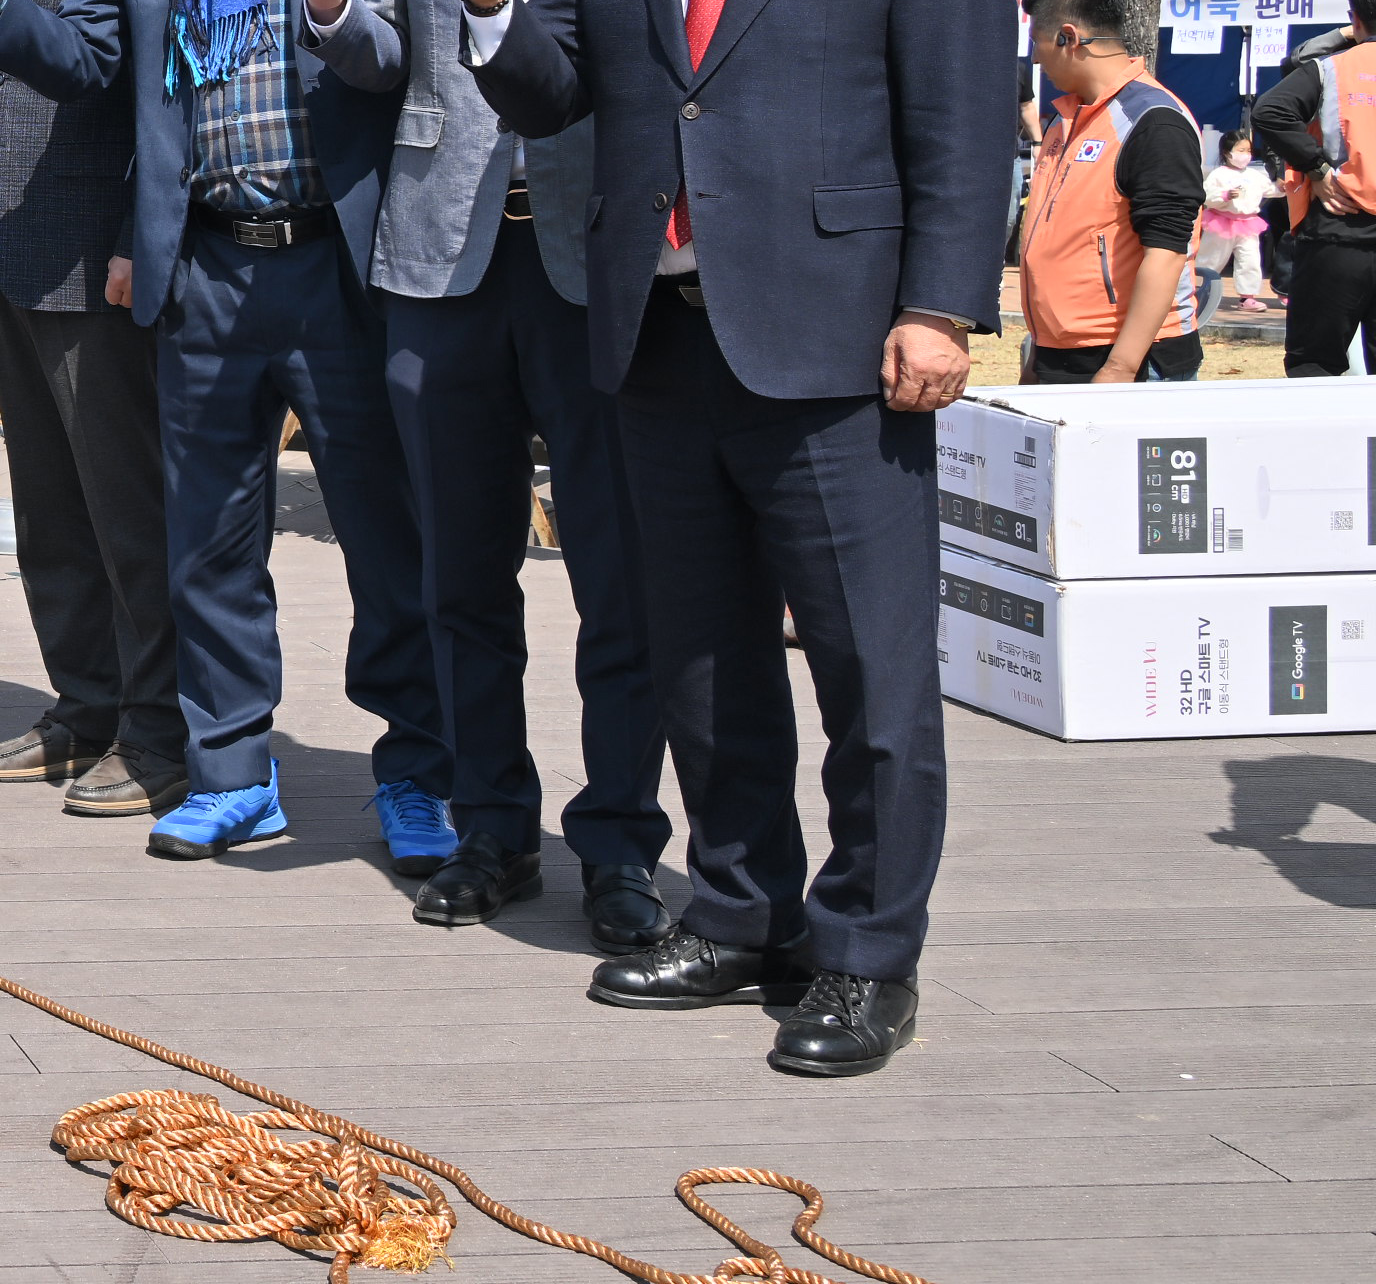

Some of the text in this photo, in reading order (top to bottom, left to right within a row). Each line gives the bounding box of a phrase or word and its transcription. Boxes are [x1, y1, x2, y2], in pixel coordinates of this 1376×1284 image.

[1170, 449, 1196, 481] 81
[1171, 484, 1179, 501] cm
[1015, 520, 1026, 541] 81
[1197, 617, 1212, 715] 구글 스마트 TV
[1291, 620, 1305, 680] Google TV
[1180, 669, 1193, 716] 32 HD
[1218, 682, 1230, 714] 이동식
